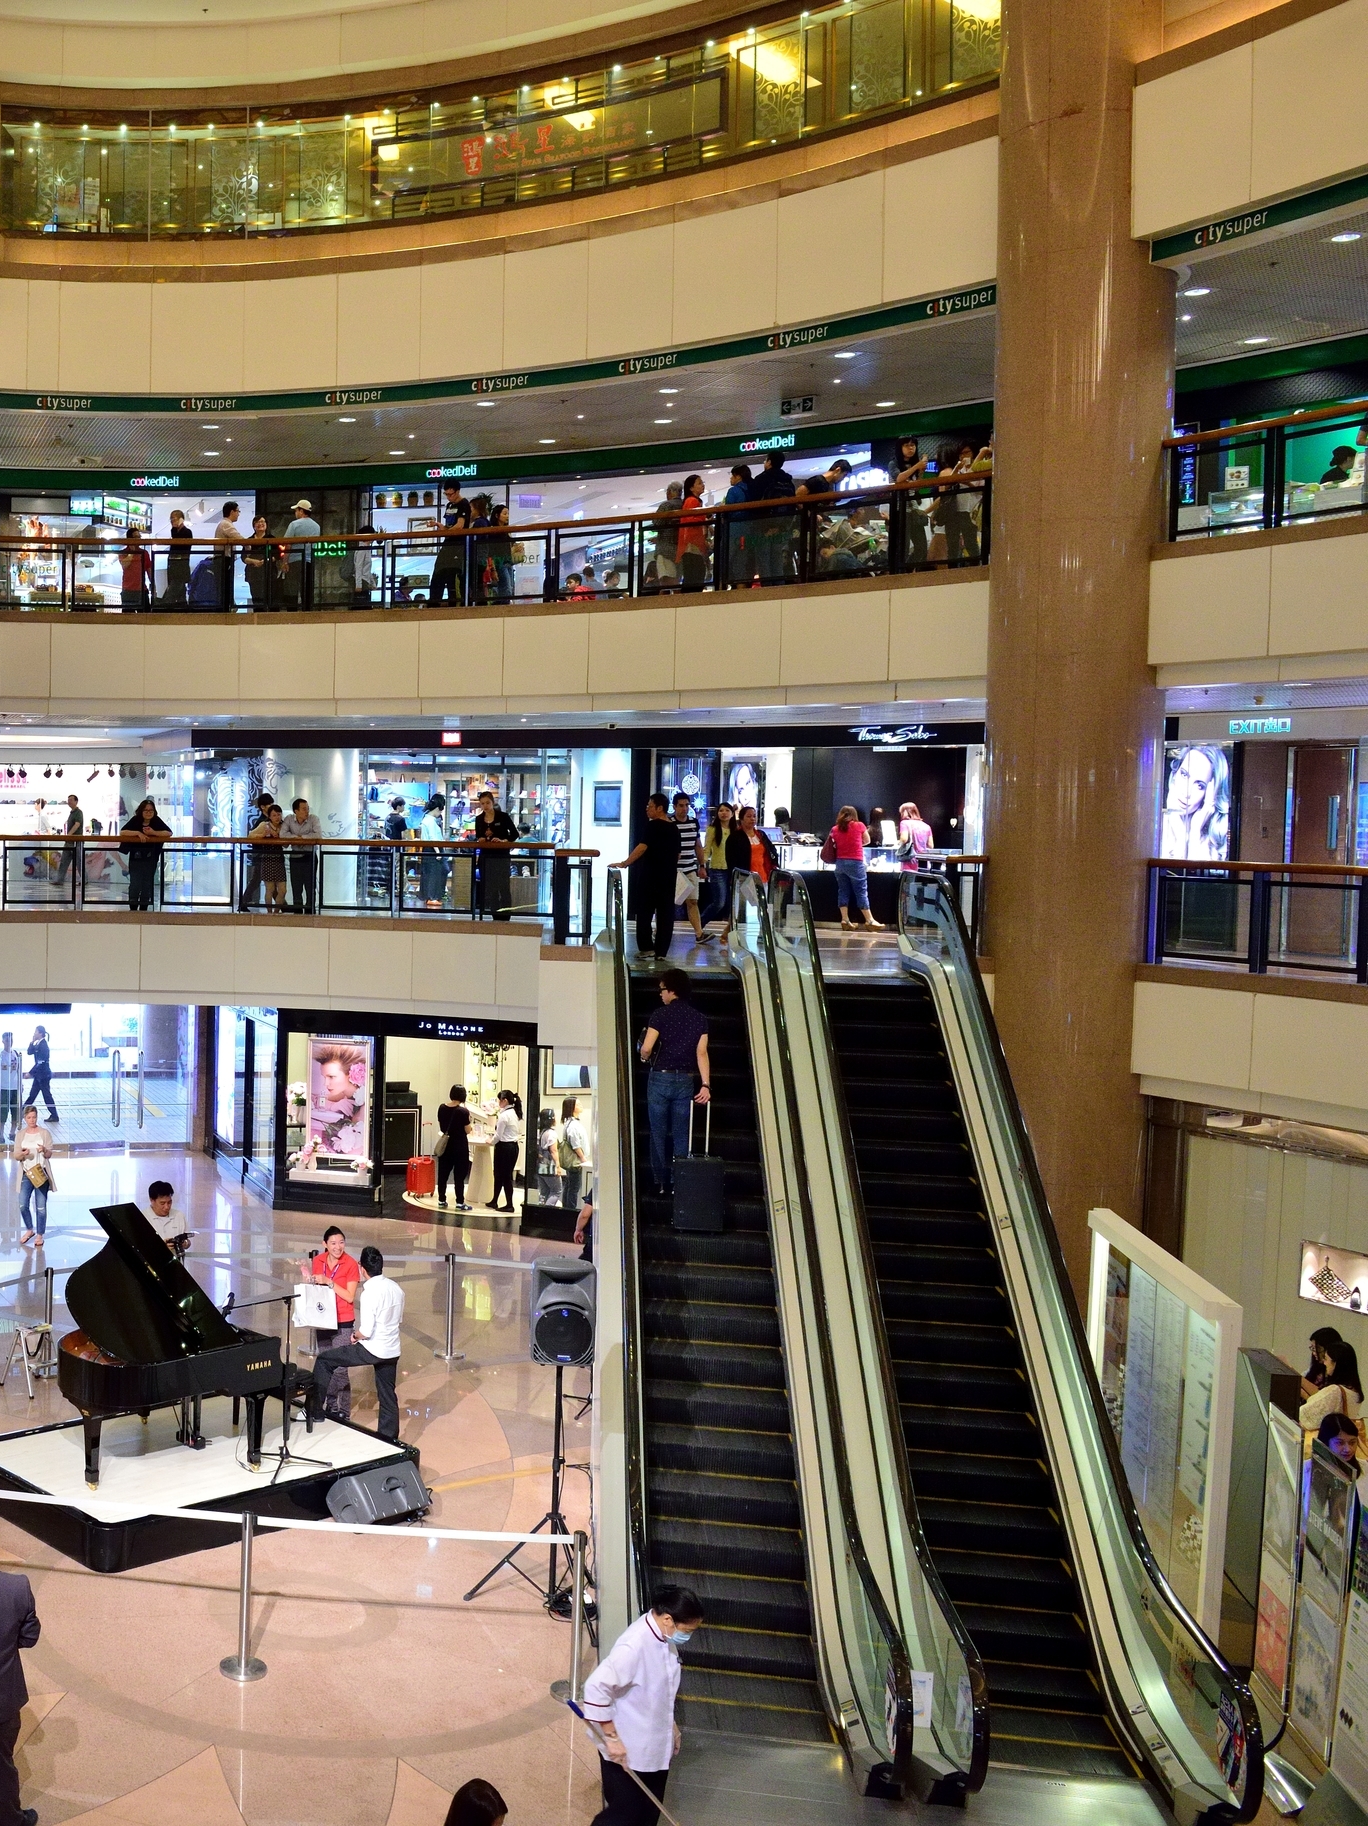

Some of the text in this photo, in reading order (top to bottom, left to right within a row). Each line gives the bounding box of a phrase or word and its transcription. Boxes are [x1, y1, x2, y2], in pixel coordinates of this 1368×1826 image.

[739, 434, 795, 452] cookedDeli
[425, 464, 477, 478] cookedDeli
[130, 475, 180, 488] cookedDeli
[1229, 716, 1292, 735] EXIT 出口
[437, 1022, 484, 1032] MALONE
[246, 1359, 272, 1371] YAMAHA
